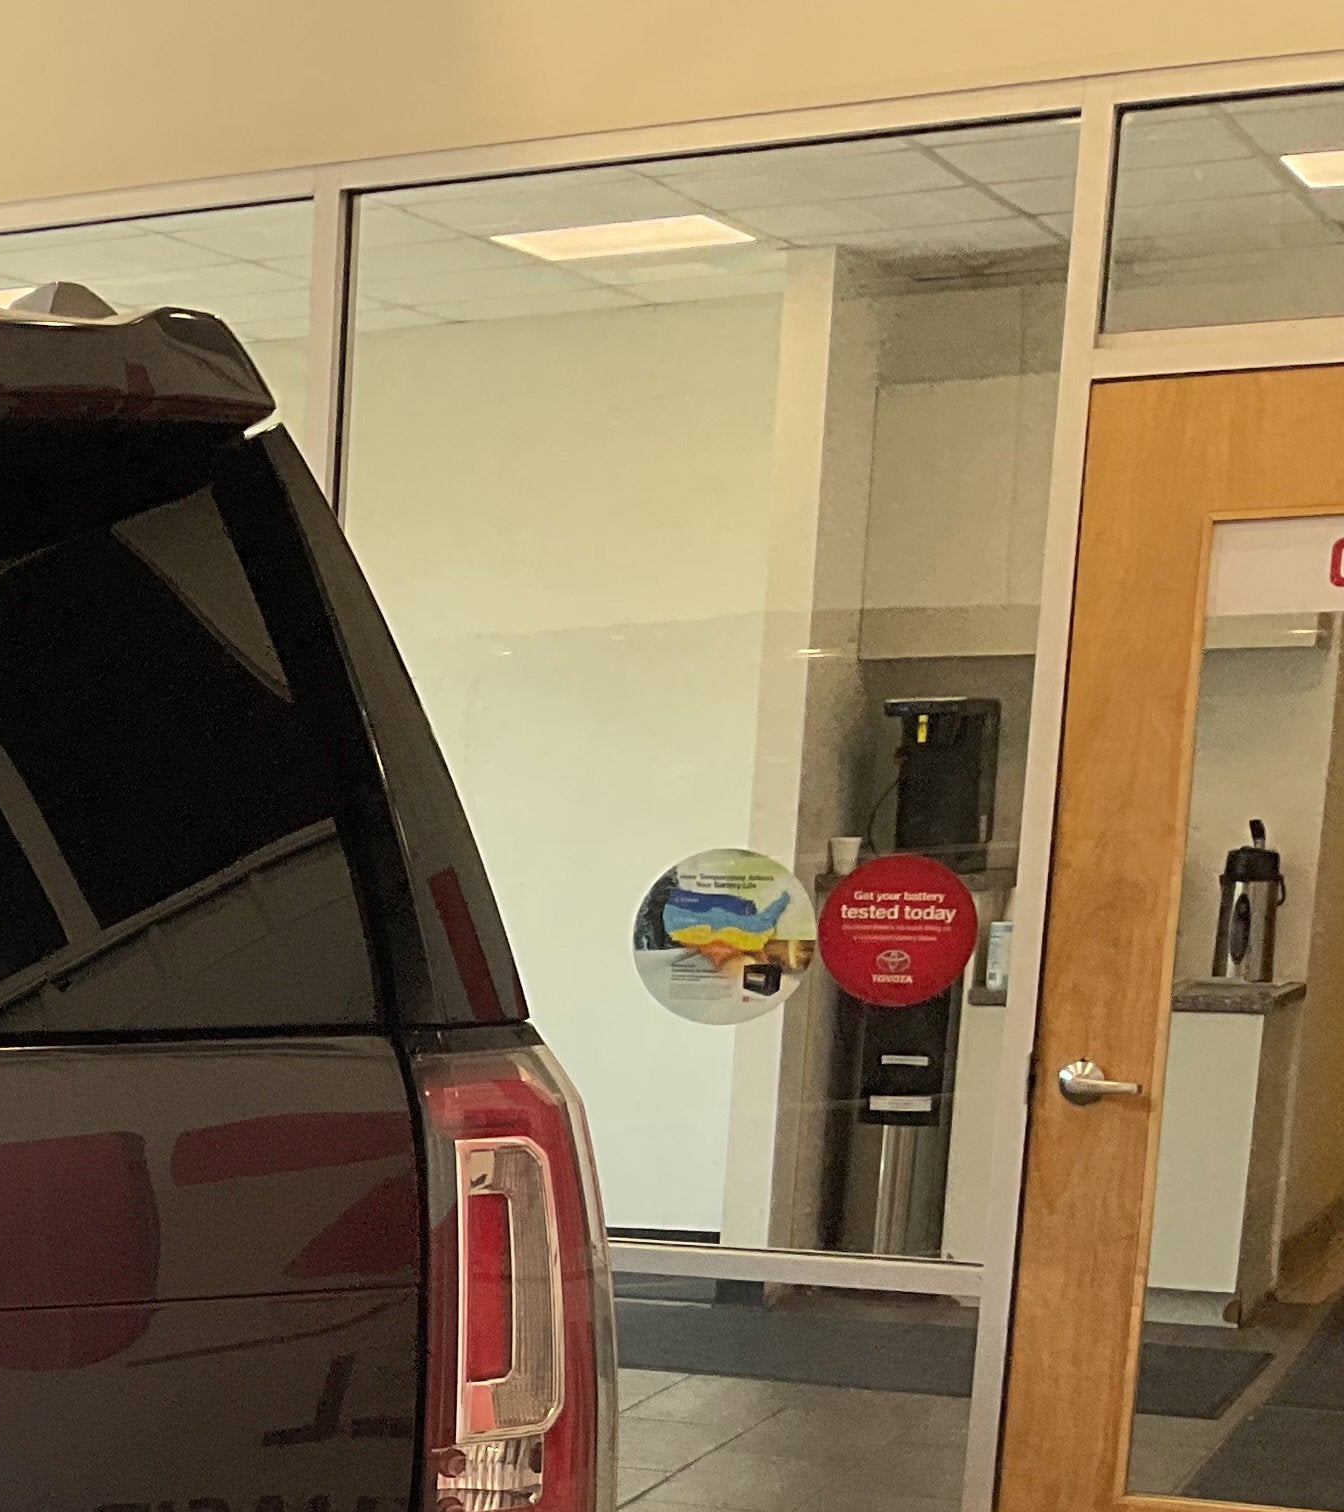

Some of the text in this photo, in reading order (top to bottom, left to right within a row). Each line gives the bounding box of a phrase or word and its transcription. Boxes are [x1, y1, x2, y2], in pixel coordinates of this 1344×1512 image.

[853, 891, 946, 903] Get your battery
[841, 904, 957, 924] tested today
[872, 974, 913, 984] TOYOTA
